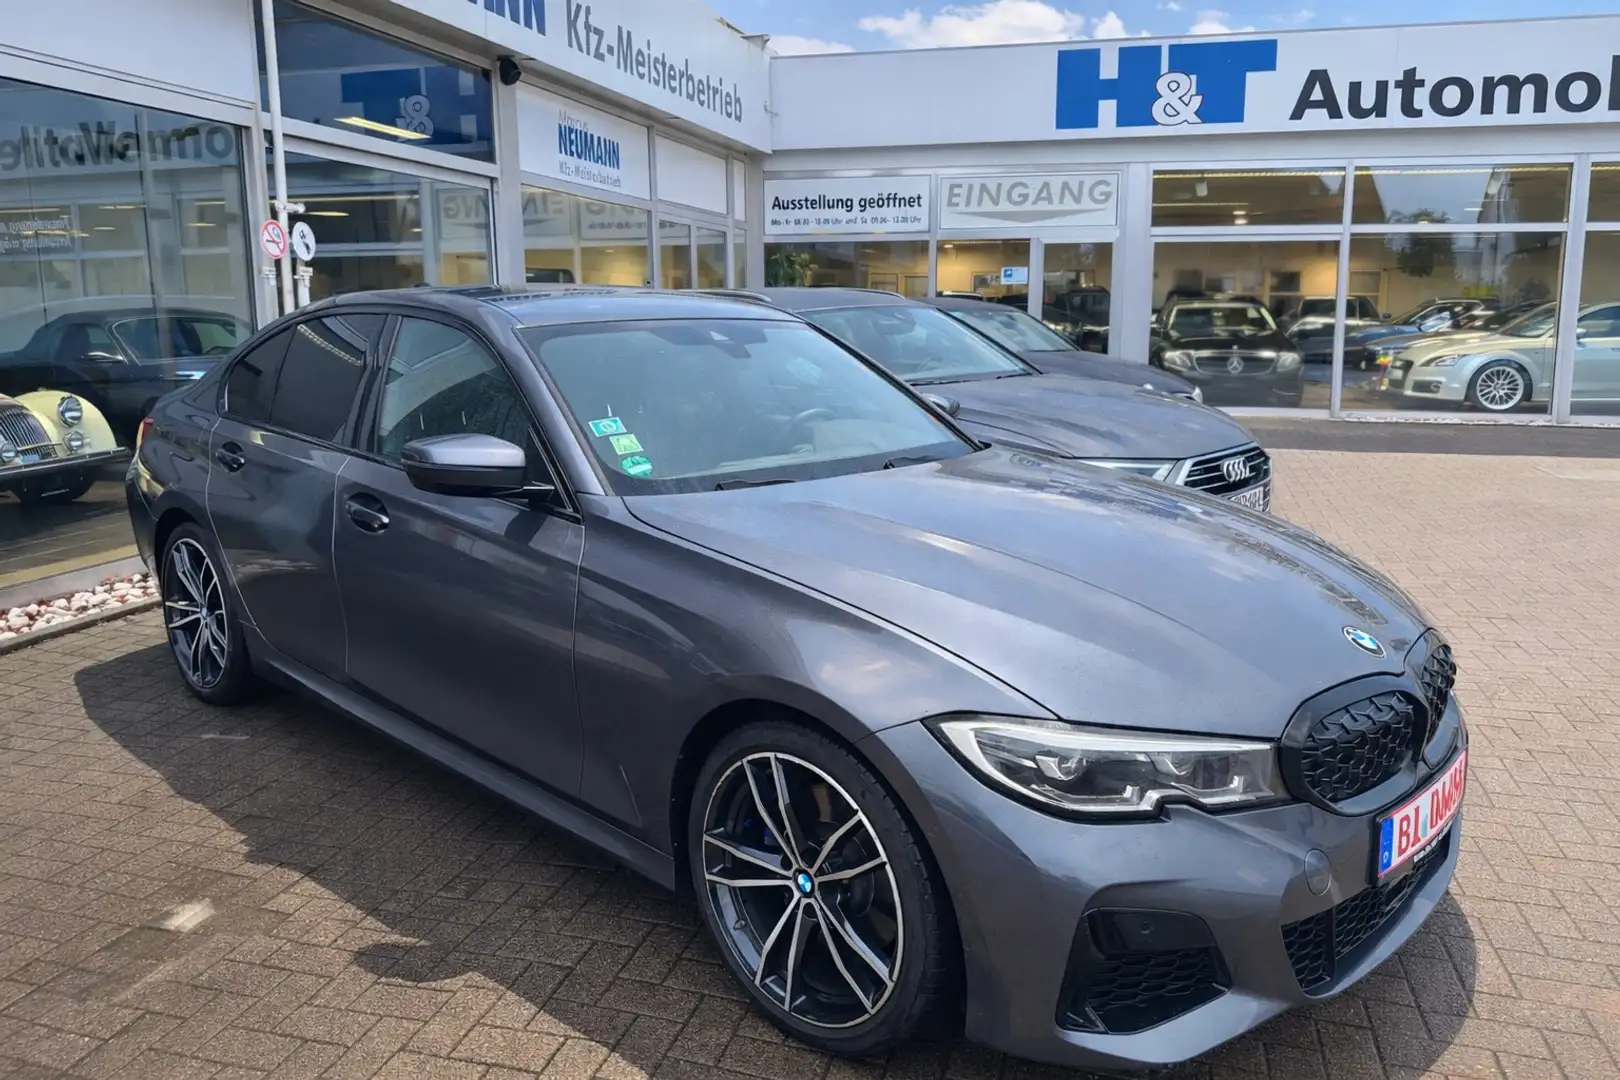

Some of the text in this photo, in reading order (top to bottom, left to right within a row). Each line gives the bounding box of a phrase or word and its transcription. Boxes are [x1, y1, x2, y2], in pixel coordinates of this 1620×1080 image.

[566, 0, 743, 123] Kfz-Meisterbetrieb
[1056, 39, 1620, 130] H&T Automo
[557, 123, 621, 171] NEUMANN
[771, 192, 923, 213] Ausstellung geöffnet
[946, 178, 1114, 208] EINGANG
